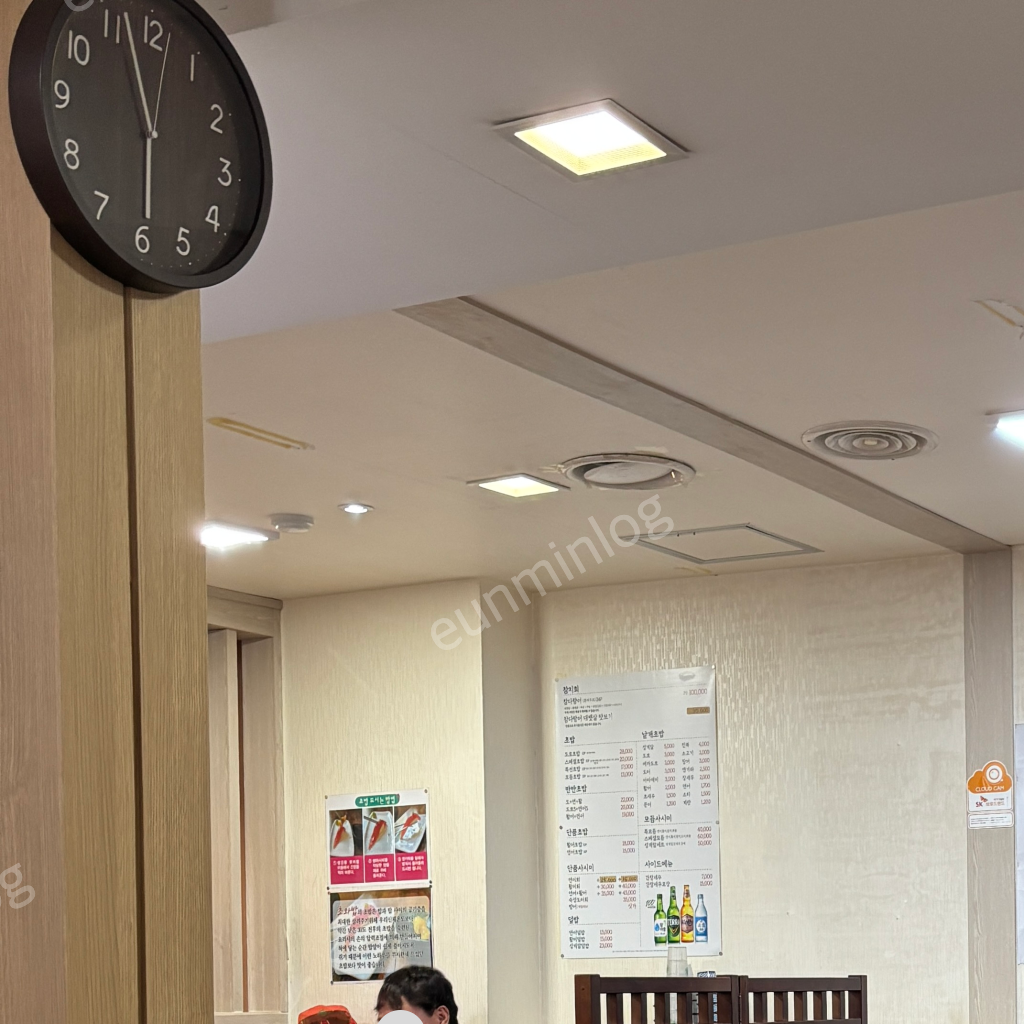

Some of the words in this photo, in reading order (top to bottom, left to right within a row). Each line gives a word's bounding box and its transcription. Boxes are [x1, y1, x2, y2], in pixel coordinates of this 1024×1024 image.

[104, 8, 120, 44] 11
[143, 15, 164, 51] 12
[68, 29, 90, 66] 10
[189, 54, 195, 82] 1
[54, 79, 70, 109] 9
[209, 103, 224, 134] 2
[63, 138, 80, 170] 8
[217, 157, 232, 187] 3
[93, 190, 110, 220] 7
[205, 204, 220, 233] 4
[134, 225, 151, 253] 6
[176, 226, 191, 256] 5
